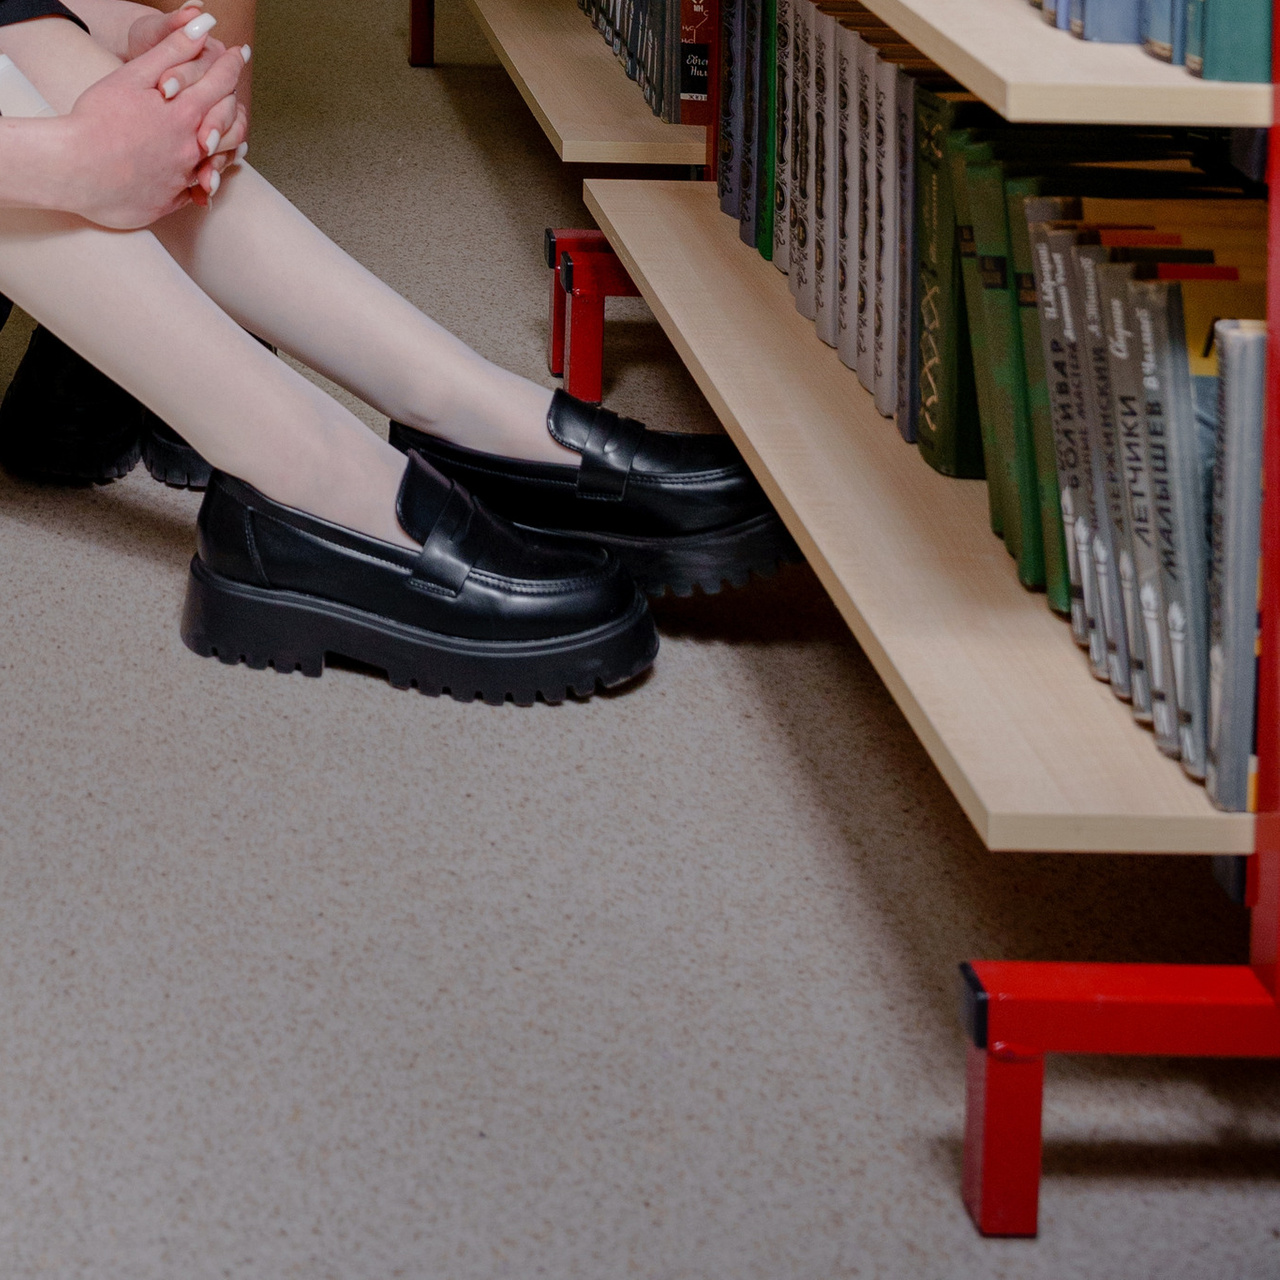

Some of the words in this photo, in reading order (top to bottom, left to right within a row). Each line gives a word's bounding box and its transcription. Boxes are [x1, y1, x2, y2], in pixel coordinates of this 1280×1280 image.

[1108, 298, 1132, 360] Сборник
[1048, 338, 1081, 489] БОЛИВАР
[1089, 345, 1126, 536] ДЗЕРЖИНСКИЙ
[1119, 394, 1152, 549] ЛЕТЧИКИ
[1146, 399, 1178, 581] МАЛЫШЕВ
